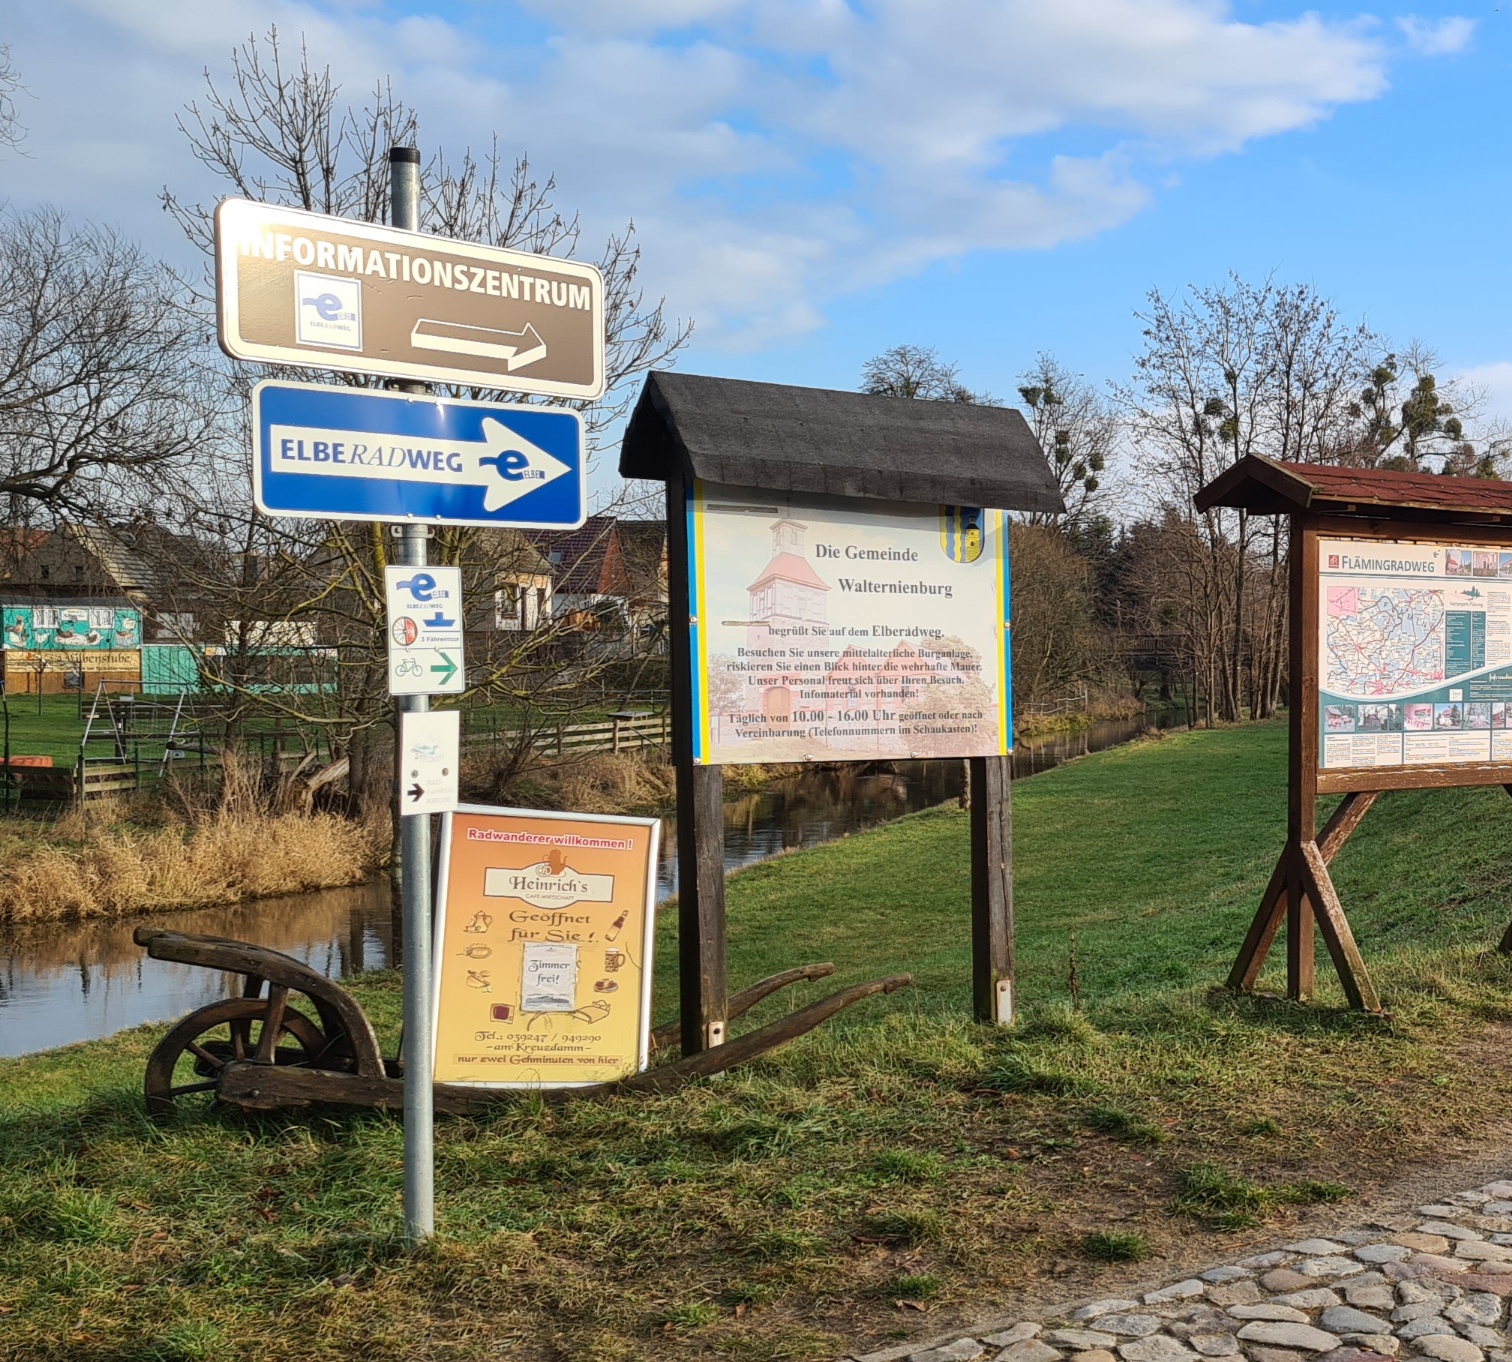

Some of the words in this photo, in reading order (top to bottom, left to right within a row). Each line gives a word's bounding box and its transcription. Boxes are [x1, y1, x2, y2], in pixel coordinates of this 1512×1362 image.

[280, 438, 463, 472] ELBERADWEG
[815, 544, 841, 559] Die
[845, 545, 919, 562] Gemeinde
[838, 578, 953, 599] Walternienburg
[768, 626, 809, 638] begrüßt
[811, 627, 827, 636] Sie
[829, 627, 847, 636] auf
[848, 627, 869, 636] dem
[872, 625, 945, 640] Elberadweg.
[737, 647, 786, 657] Besuchen
[789, 648, 805, 657] Sie
[807, 650, 840, 658] unsere
[843, 648, 916, 658] mittelalterliche
[726, 661, 773, 671] riskieren
[776, 662, 792, 671] Sie
[794, 662, 821, 671] einen
[824, 662, 852, 671] Blick
[852, 662, 882, 671] hinter
[884, 662, 899, 671] die
[901, 661, 948, 671] wehrhafte
[950, 662, 983, 671] Mauer.
[748, 675, 779, 686] Unser
[782, 675, 825, 686] Personal
[828, 676, 853, 685] freut
[855, 676, 874, 685] sich
[876, 676, 899, 685] über
[901, 675, 927, 685] Ihren
[930, 675, 965, 685] Besuch.
[800, 689, 862, 699] Infomaterial
[865, 689, 919, 698] vorhanden!
[728, 713, 767, 725] Täglich
[770, 715, 789, 723] von
[792, 710, 824, 722] 10.00
[837, 710, 869, 722] 16.00
[872, 709, 896, 721] Uhr
[898, 711, 936, 722] geöffnet
[938, 711, 960, 720] oder
[961, 711, 983, 719] nach
[735, 728, 806, 739] Vereinbarung
[808, 726, 896, 738] (Telefonnummern
[898, 725, 911, 734] im
[913, 724, 978, 735] Schaukasten)!
[468, 828, 551, 844] Radwanderer
[554, 835, 625, 848] willkommen
[509, 910, 591, 926] Geöffnet
[507, 927, 540, 942] für
[545, 929, 582, 942] Sie
[528, 959, 571, 973] Zimmer
[536, 974, 560, 987] frei!
[506, 1033, 549, 1042] 039247
[561, 1034, 602, 1043] 949290
[480, 1055, 507, 1063] zwei
[510, 1055, 574, 1065] Gehminuten
[598, 1055, 620, 1065] hier
